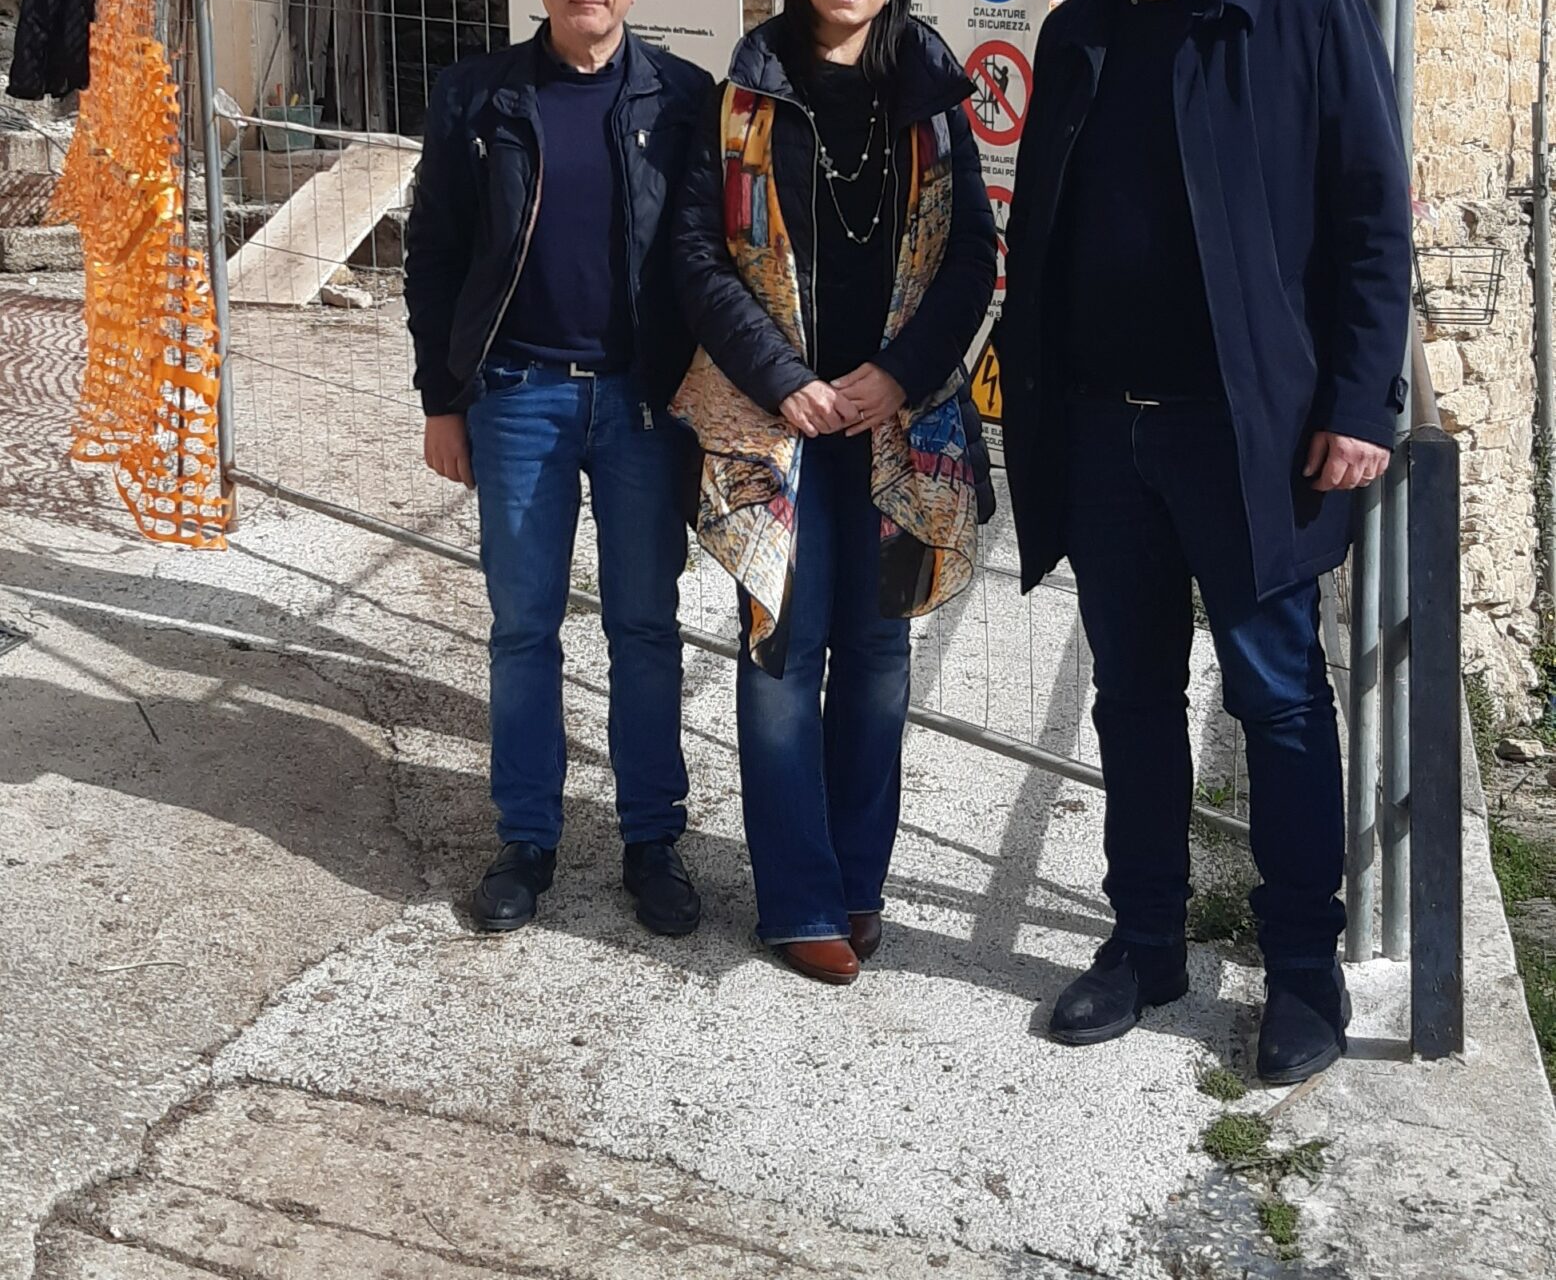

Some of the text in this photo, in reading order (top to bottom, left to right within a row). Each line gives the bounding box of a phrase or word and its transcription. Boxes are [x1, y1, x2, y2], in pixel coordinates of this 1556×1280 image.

[973, 7, 1026, 19] CALZATURE
[967, 18, 1031, 32] DI SICUREZZA
[990, 154, 1015, 165] SALIRE
[992, 167, 1005, 175] DAI
